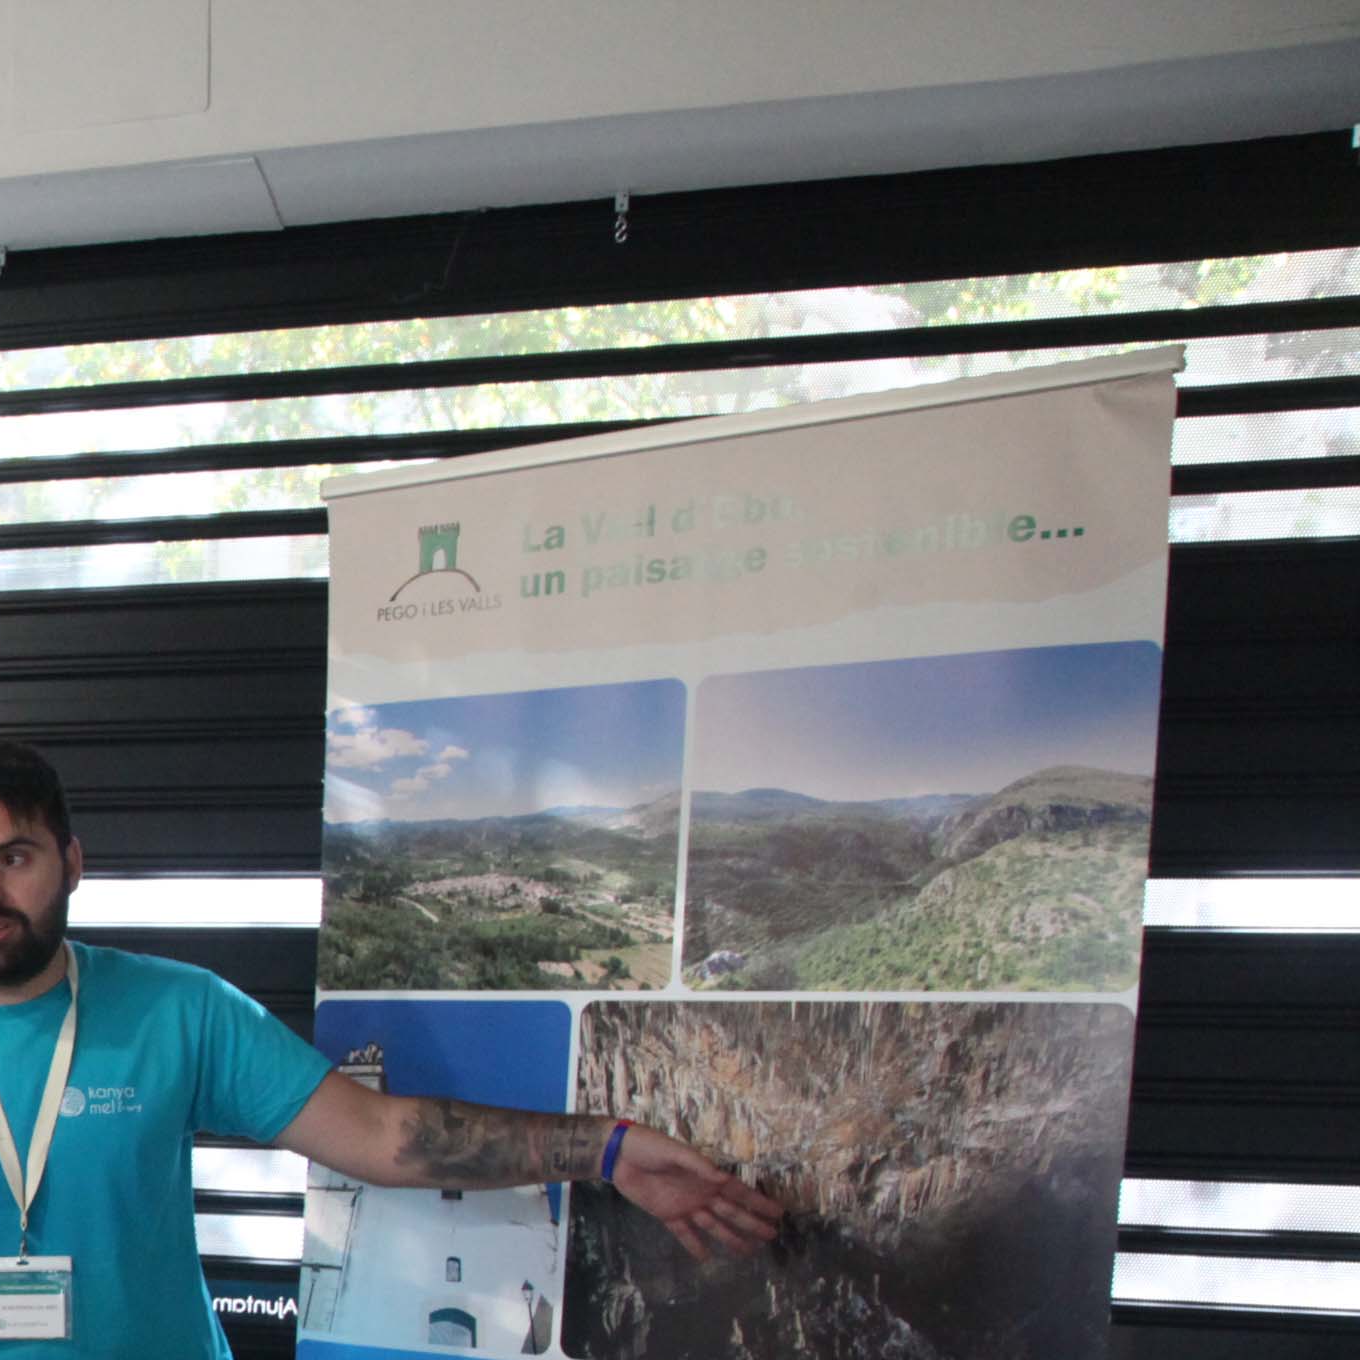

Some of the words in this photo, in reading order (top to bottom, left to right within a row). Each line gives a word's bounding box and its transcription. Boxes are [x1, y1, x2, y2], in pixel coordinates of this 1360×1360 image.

[522, 522, 566, 554] La
[579, 504, 656, 545] Vl
[520, 568, 566, 599] un
[581, 547, 768, 598] paisae
[376, 603, 418, 623] PEGO
[429, 598, 455, 617] LES
[459, 592, 503, 614] VALLS
